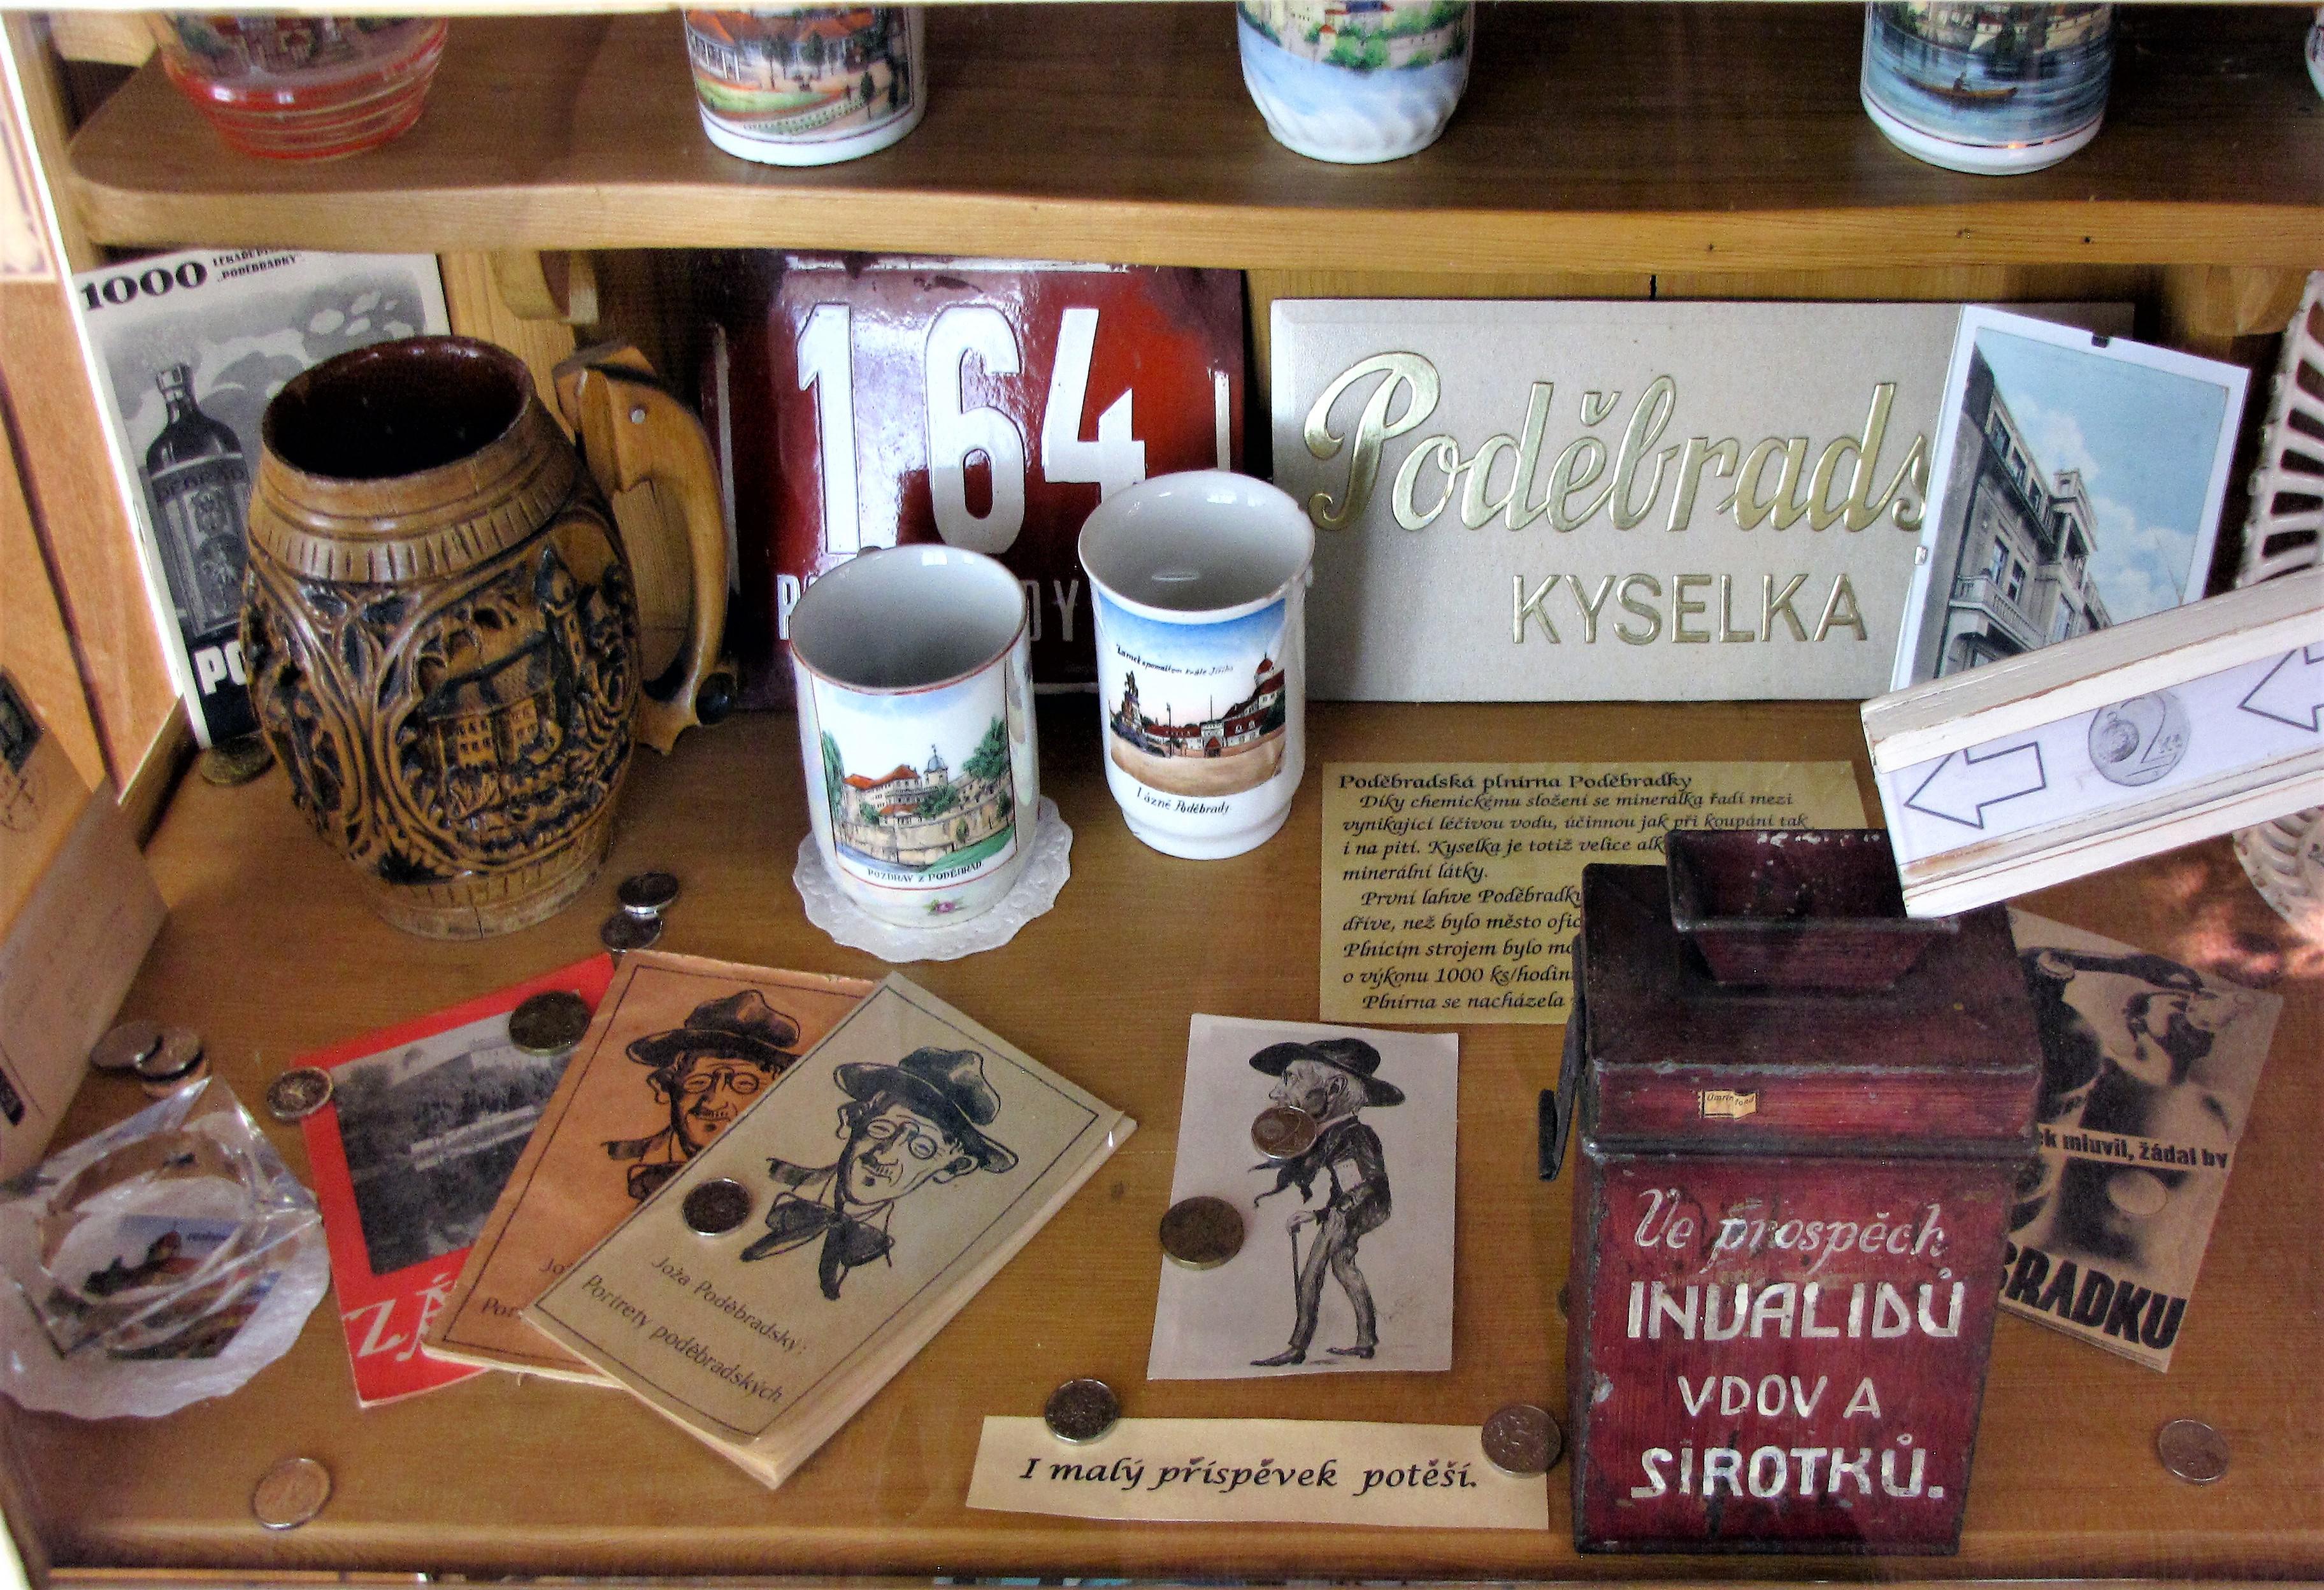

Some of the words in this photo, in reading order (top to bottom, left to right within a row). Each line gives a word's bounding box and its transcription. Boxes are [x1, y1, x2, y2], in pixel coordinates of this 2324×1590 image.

[82, 261, 208, 310] 1000
[796, 302, 1145, 554] 164
[1512, 573, 1868, 645] KYSELKA
[1339, 773, 1475, 789] Poděbradská
[1568, 772, 1693, 792] Poděbradky
[1359, 794, 1404, 813] Díky
[1410, 794, 1523, 811] chemickému
[1528, 793, 1589, 807] složení
[1593, 796, 1610, 806] se
[1614, 794, 1705, 809] minerálka
[1709, 791, 1746, 806] řadí
[1749, 793, 1795, 806] mezi
[1342, 816, 1435, 837] vynikající
[1438, 816, 1505, 831] léčivou
[1510, 815, 1557, 831] vodu,
[1564, 815, 1637, 829] účinnou
[1637, 814, 1670, 833] jak
[1672, 814, 1700, 829] při
[1704, 813, 1776, 830] koupání
[1780, 812, 1811, 830] tak
[1343, 841, 1350, 855] i
[1355, 843, 1378, 855] na
[1428, 838, 1502, 859] Kyselka
[1503, 839, 1523, 858] je
[1529, 838, 1574, 852] totiž
[1579, 836, 1631, 851] velice
[1637, 836, 1665, 853] alk
[867, 868, 914, 883] POZDRAV
[1342, 865, 1432, 881] minerální
[1437, 862, 1488, 884] látky.
[1361, 891, 1416, 906] První
[1422, 888, 1472, 905] lahve
[1342, 916, 1396, 933] dříve,
[1403, 915, 1436, 929] než
[1441, 912, 1481, 935] bylo
[1486, 915, 1542, 929] město
[1547, 912, 1581, 935] ofic
[1424, 942, 1497, 962] strojem
[1502, 938, 1542, 962] bylo
[1343, 971, 1354, 984] o
[1359, 966, 1429, 990] výkonu
[1434, 967, 1484, 984] 1000
[1490, 964, 1571, 987] ks/hodin
[1441, 995, 1460, 1008] se
[1467, 991, 1565, 1008] nacházela
[2063, 1134, 2134, 1161] mluvil,
[2139, 1142, 2196, 1165] žádal
[1633, 1189, 1695, 1249] Ve
[1697, 1203, 1949, 1275] prospěch
[651, 1256, 691, 1286] Joža
[581, 1274, 649, 1328] Portrety
[1676, 1373, 1828, 1417] VDOV
[1842, 1377, 1881, 1418] A
[1020, 1458, 1040, 1480] I
[1049, 1457, 1144, 1491] malý
[1147, 1456, 1337, 1493] příspěvek
[1353, 1459, 1477, 1496] potěší.
